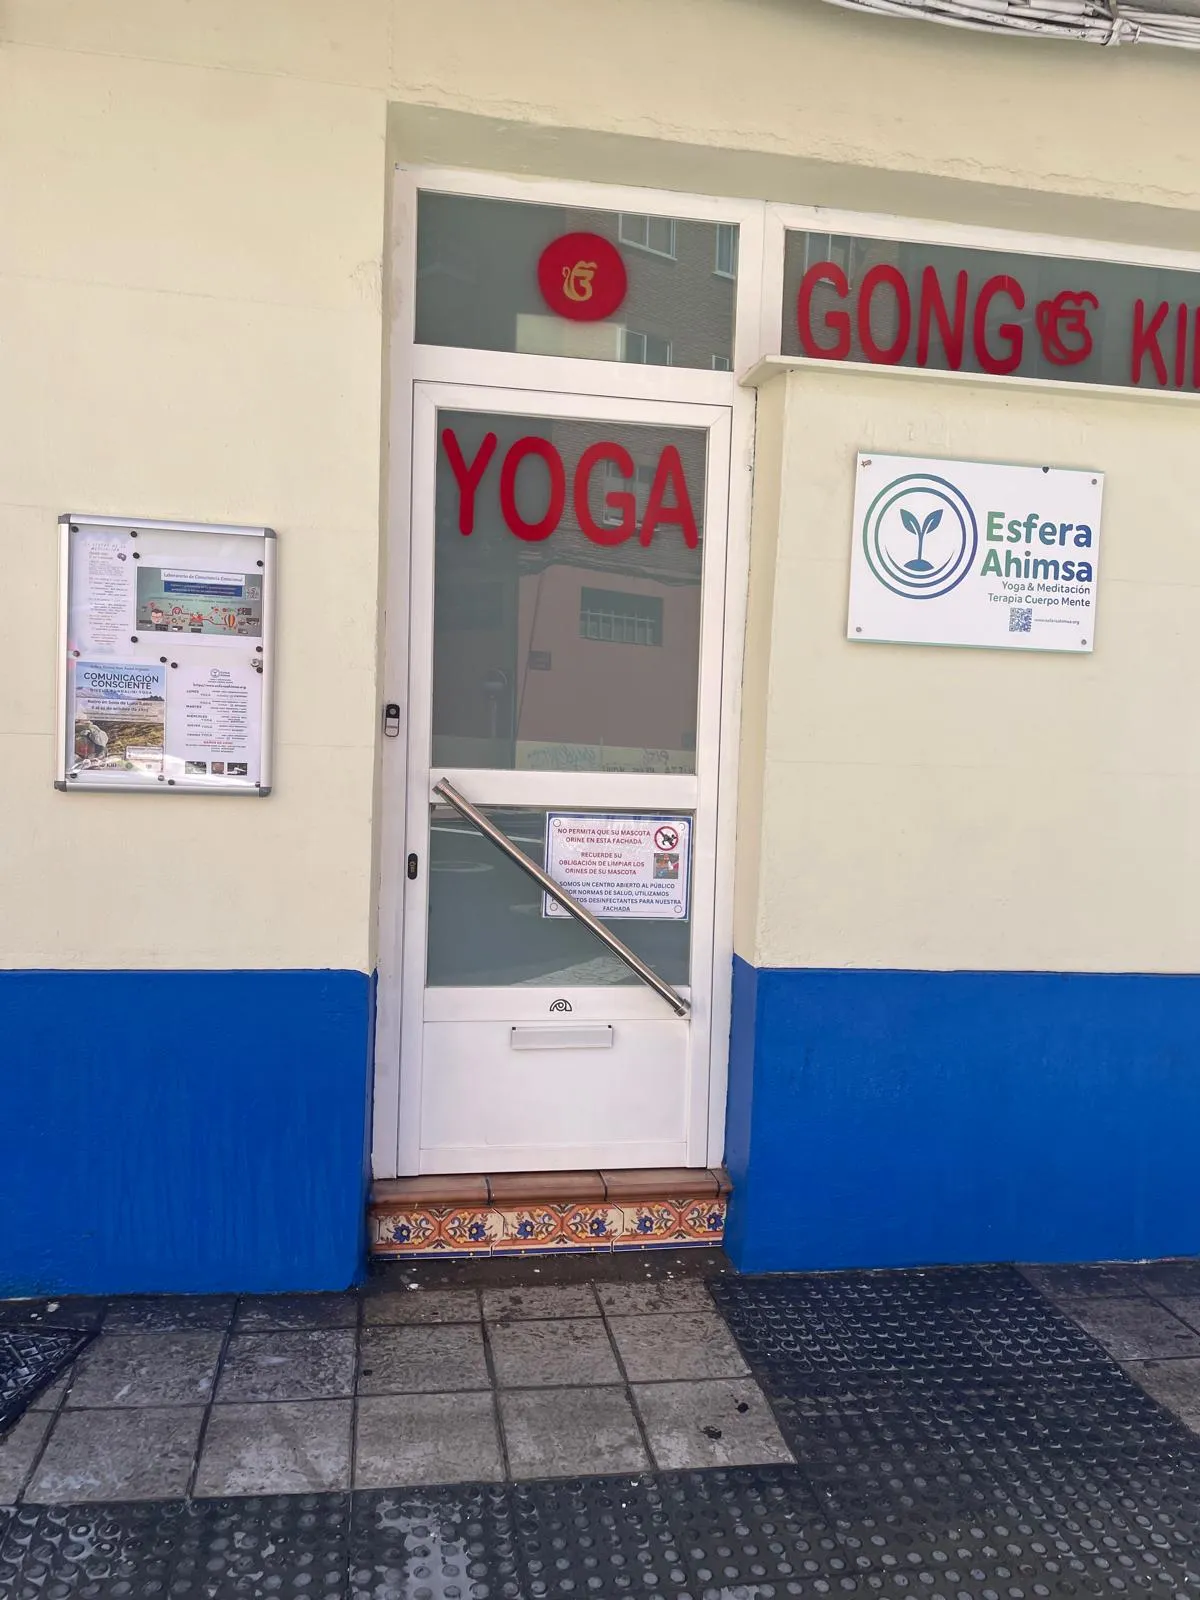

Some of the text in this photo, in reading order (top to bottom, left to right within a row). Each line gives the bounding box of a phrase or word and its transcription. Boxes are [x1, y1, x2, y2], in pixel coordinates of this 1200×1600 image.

[797, 261, 1025, 375] GONG
[442, 428, 699, 549] YOGA
[986, 511, 1092, 548] Esfera
[980, 548, 1092, 582] Ahimsa
[1002, 581, 1090, 594] Yoga & Meditación
[988, 593, 1091, 607] Terapia Cuerpo Mente
[84, 672, 159, 683] COMUNICACIÓN
[91, 680, 152, 690] CONSCIENTE
